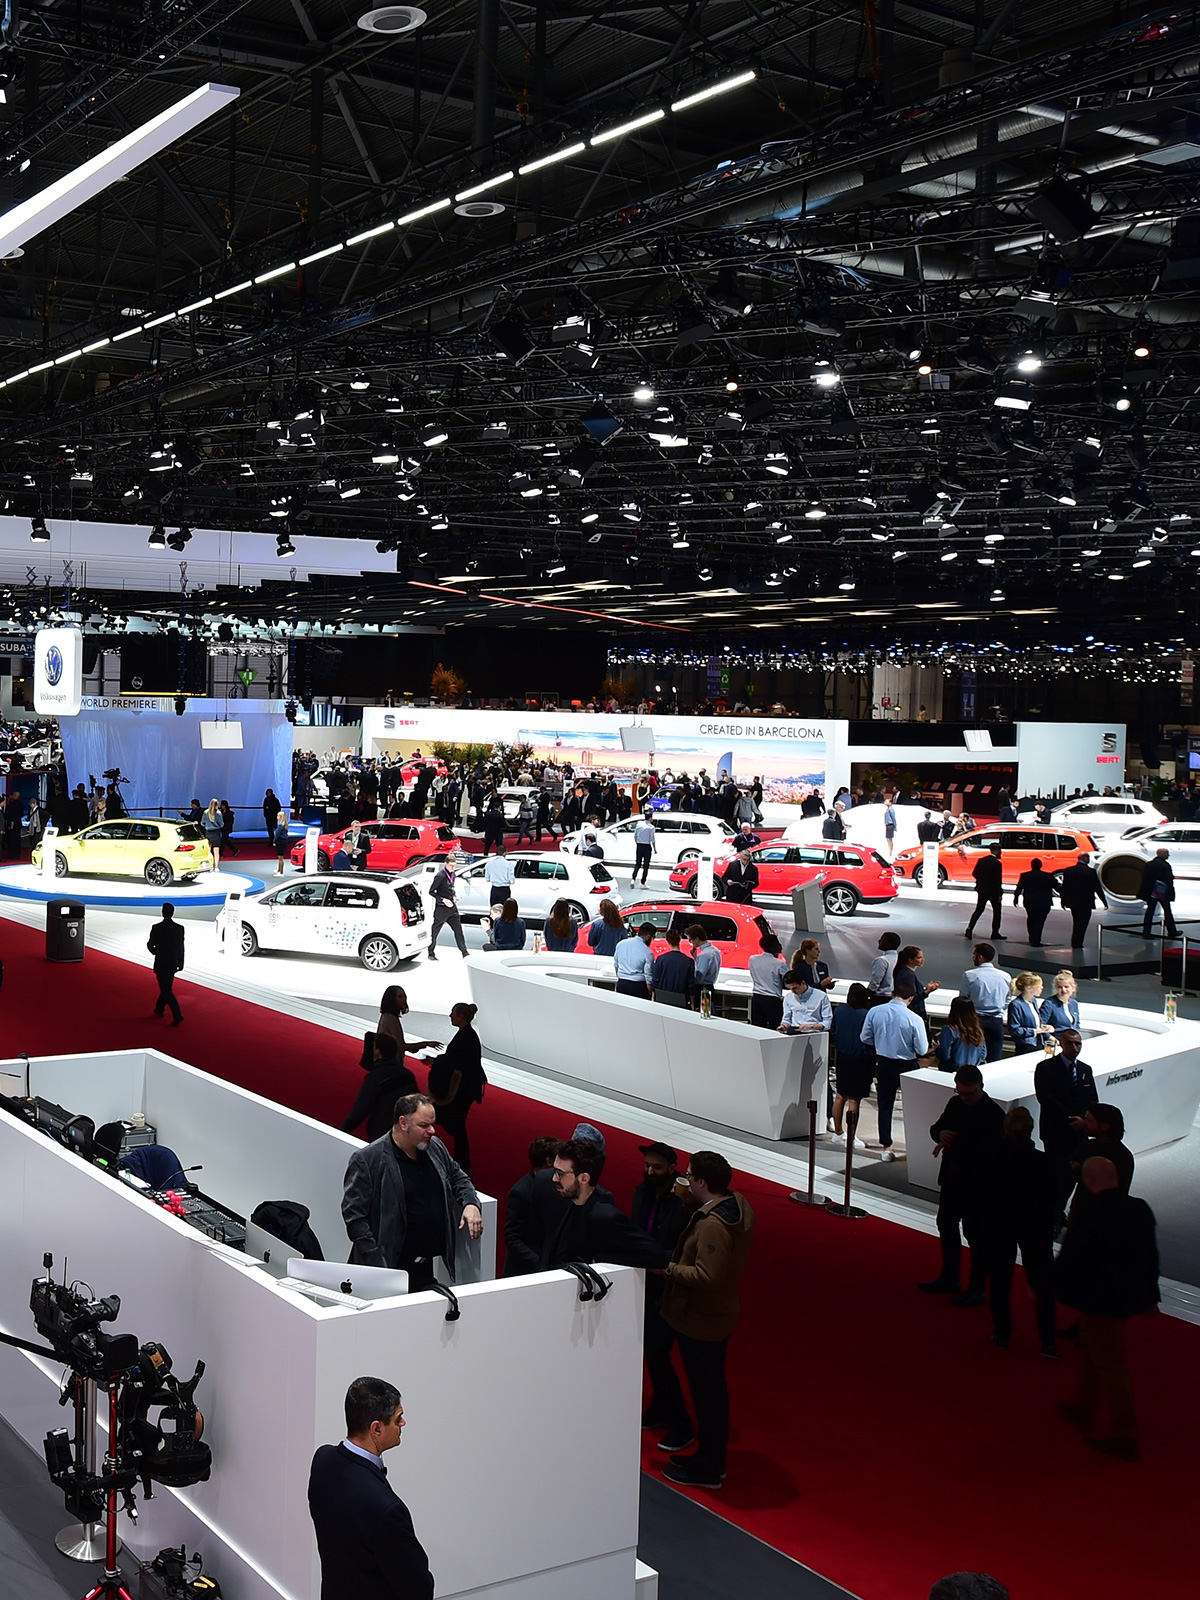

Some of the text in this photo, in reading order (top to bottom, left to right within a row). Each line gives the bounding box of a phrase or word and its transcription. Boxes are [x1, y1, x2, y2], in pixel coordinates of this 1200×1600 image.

[39, 692, 67, 703] Volkswagen
[111, 699, 157, 709] PREMIERE
[699, 724, 824, 739] CREATED IN BARCELONA
[1096, 755, 1122, 763] SEAT
[954, 764, 1013, 773] CUPRA
[1105, 1067, 1144, 1087] Information
